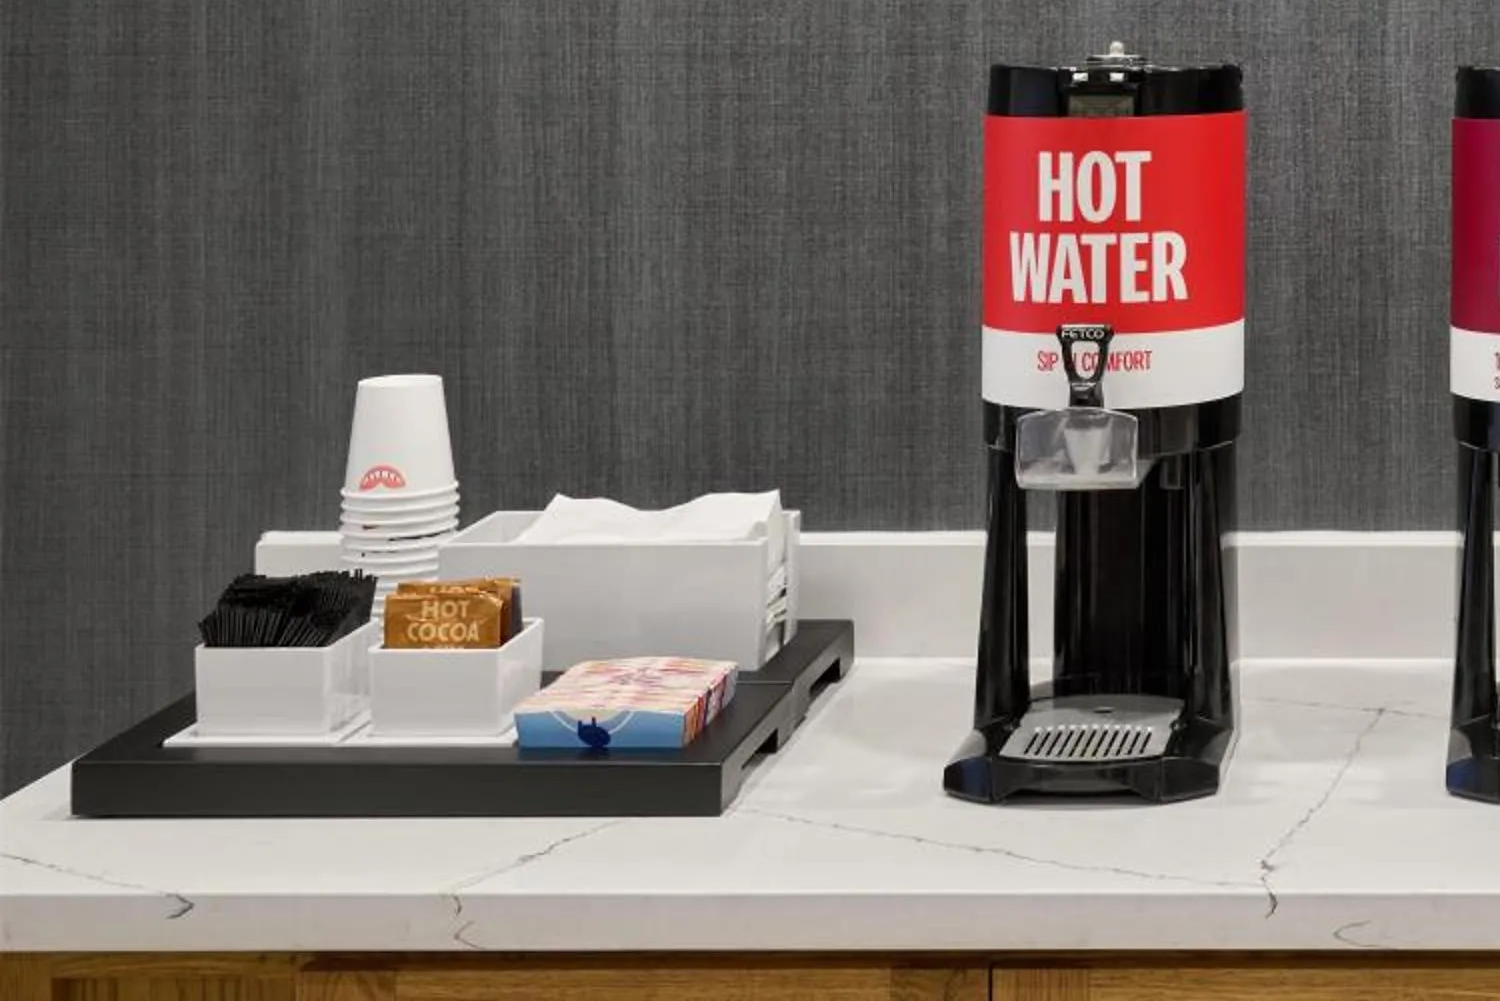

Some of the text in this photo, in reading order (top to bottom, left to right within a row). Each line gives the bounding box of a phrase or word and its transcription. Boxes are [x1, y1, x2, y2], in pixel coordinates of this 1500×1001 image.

[1038, 151, 1152, 223] HOT
[1010, 232, 1188, 303] WATER
[1061, 328, 1105, 339] FETCO
[1037, 351, 1059, 372] SIP
[422, 600, 471, 620] HOT
[407, 621, 480, 642] COCOA
